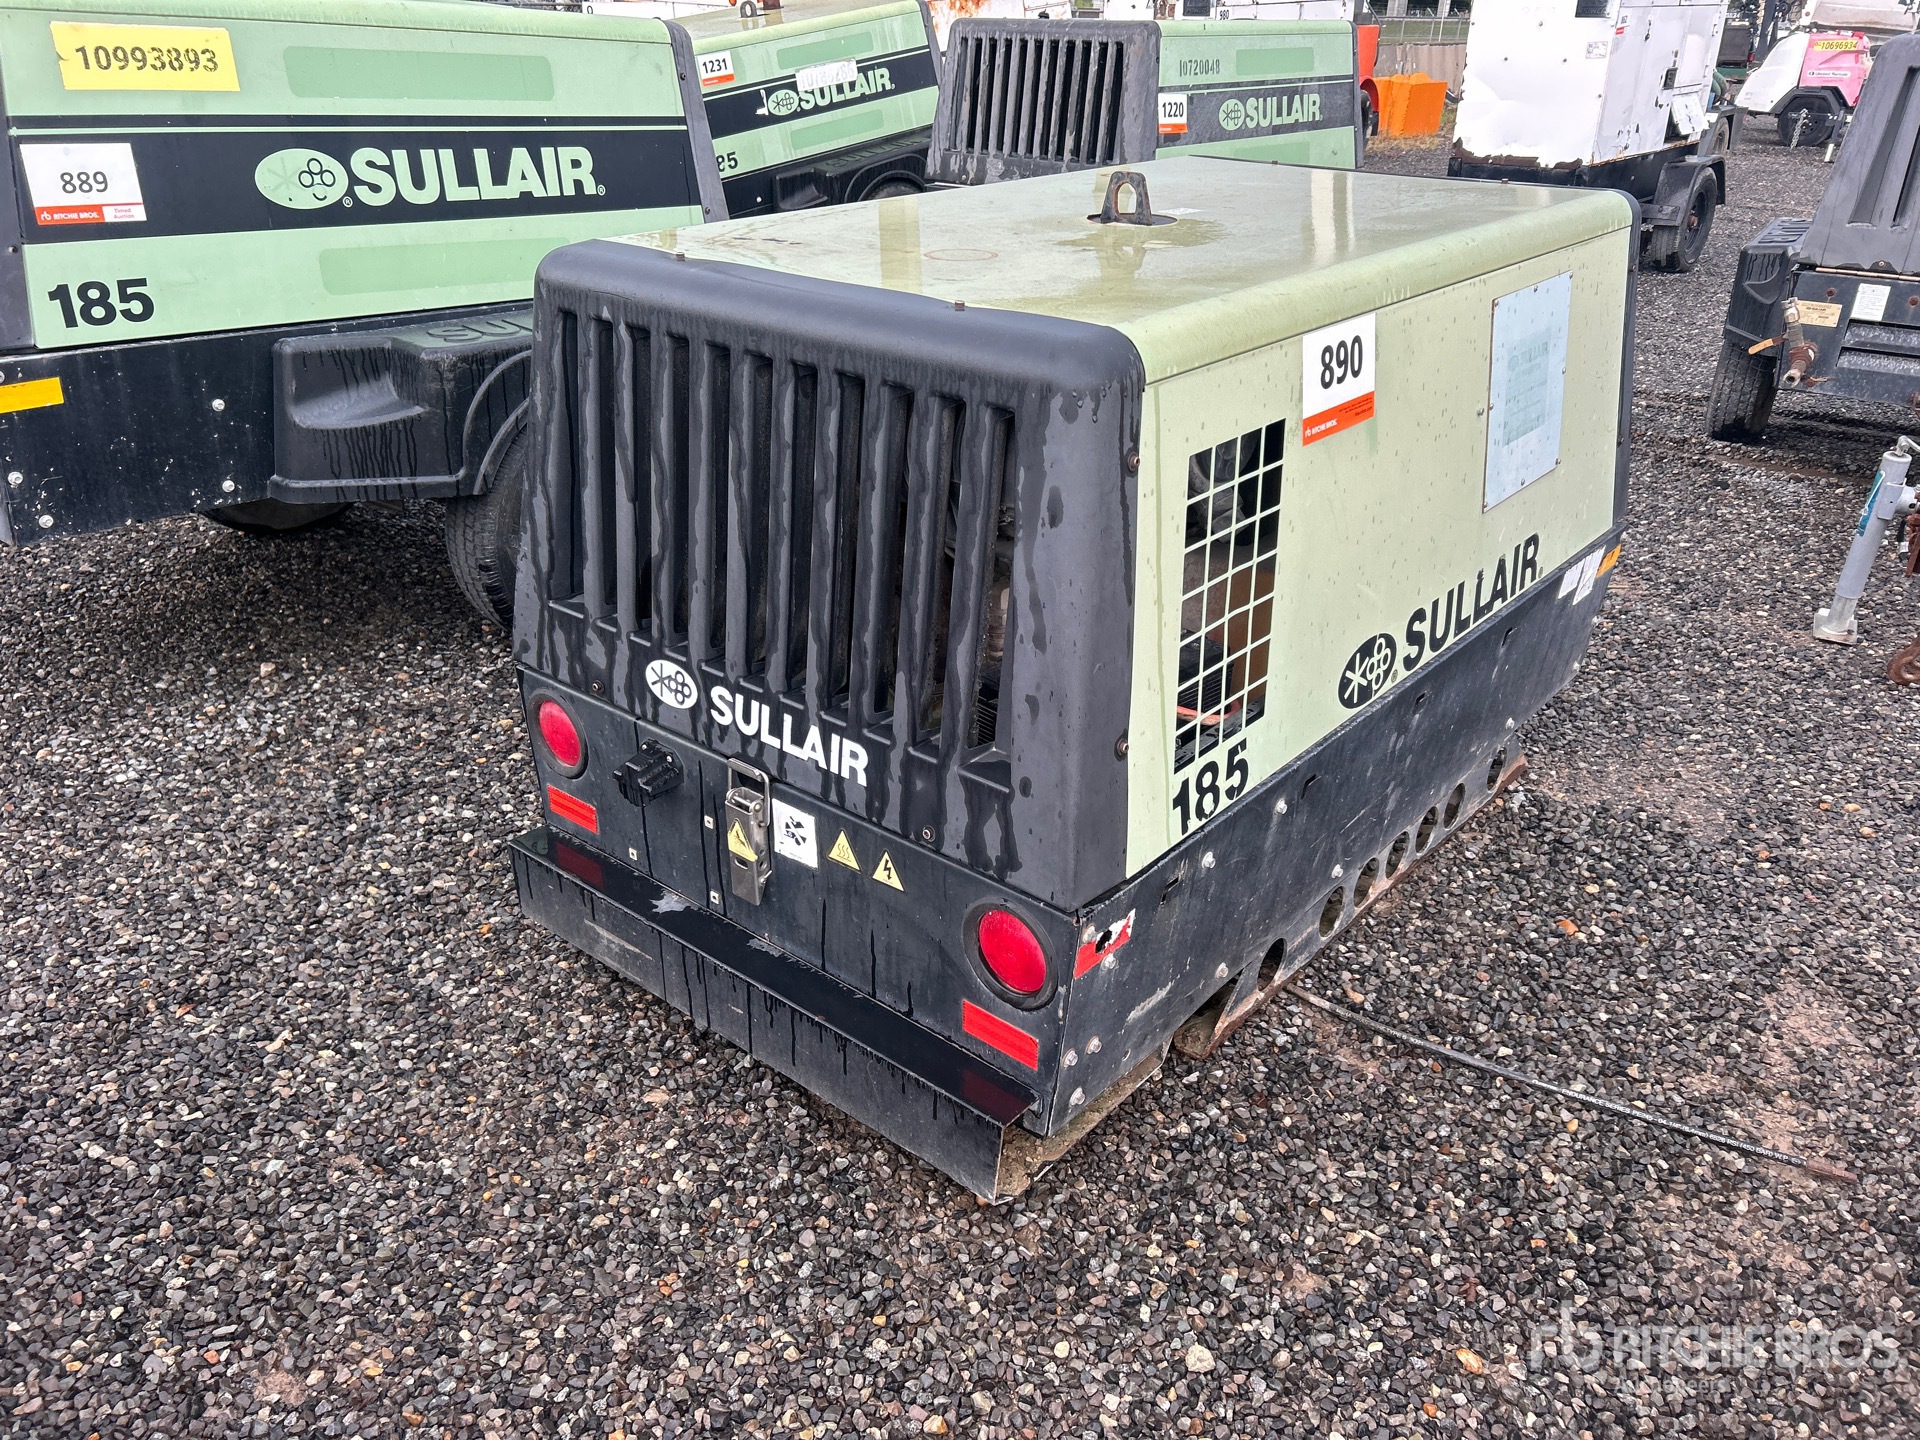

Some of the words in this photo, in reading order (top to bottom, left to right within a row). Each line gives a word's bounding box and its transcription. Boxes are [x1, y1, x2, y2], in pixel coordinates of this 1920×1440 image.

[75, 45, 219, 72] 10993893
[702, 57, 728, 75] 1231
[1179, 58, 1221, 77] 10720048
[1162, 101, 1184, 118] 1220
[1245, 93, 1321, 129] SULLAIR
[60, 170, 108, 194] 889
[351, 147, 598, 206] SULLAIR
[53, 212, 78, 220] RITCHIE
[48, 278, 155, 329] 185
[1320, 334, 1363, 390] 890
[1403, 532, 1541, 672] SULLAIR
[711, 685, 869, 787] SULLAIR
[1172, 737, 1249, 836] 185
[1561, 1088, 1604, 1107] ENDURANCE
[1604, 1099, 1631, 1114] SERIES
